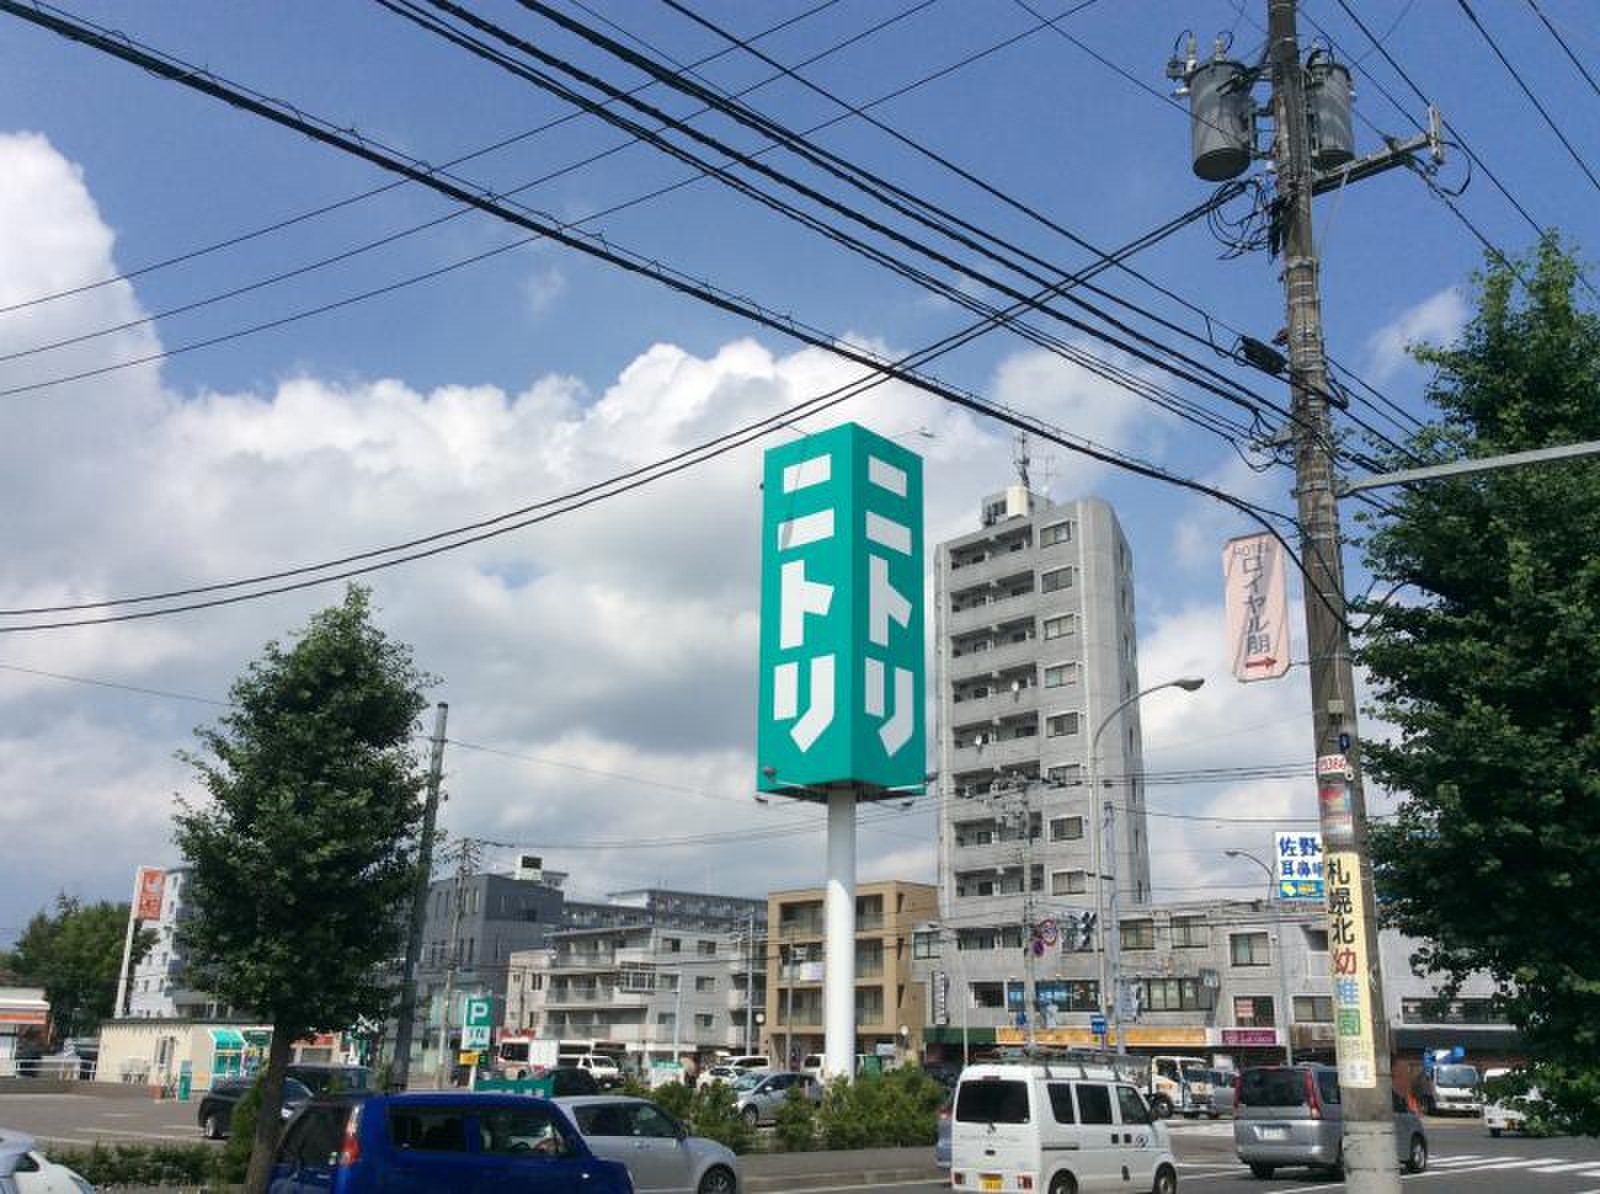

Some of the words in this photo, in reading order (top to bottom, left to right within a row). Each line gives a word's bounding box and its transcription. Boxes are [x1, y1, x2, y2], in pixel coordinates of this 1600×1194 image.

[773, 453, 836, 753] ニトリ
[864, 454, 914, 758] ニトリ
[470, 1001, 489, 1025] P
[1328, 857, 1361, 1037] 札幌北幼稚園
